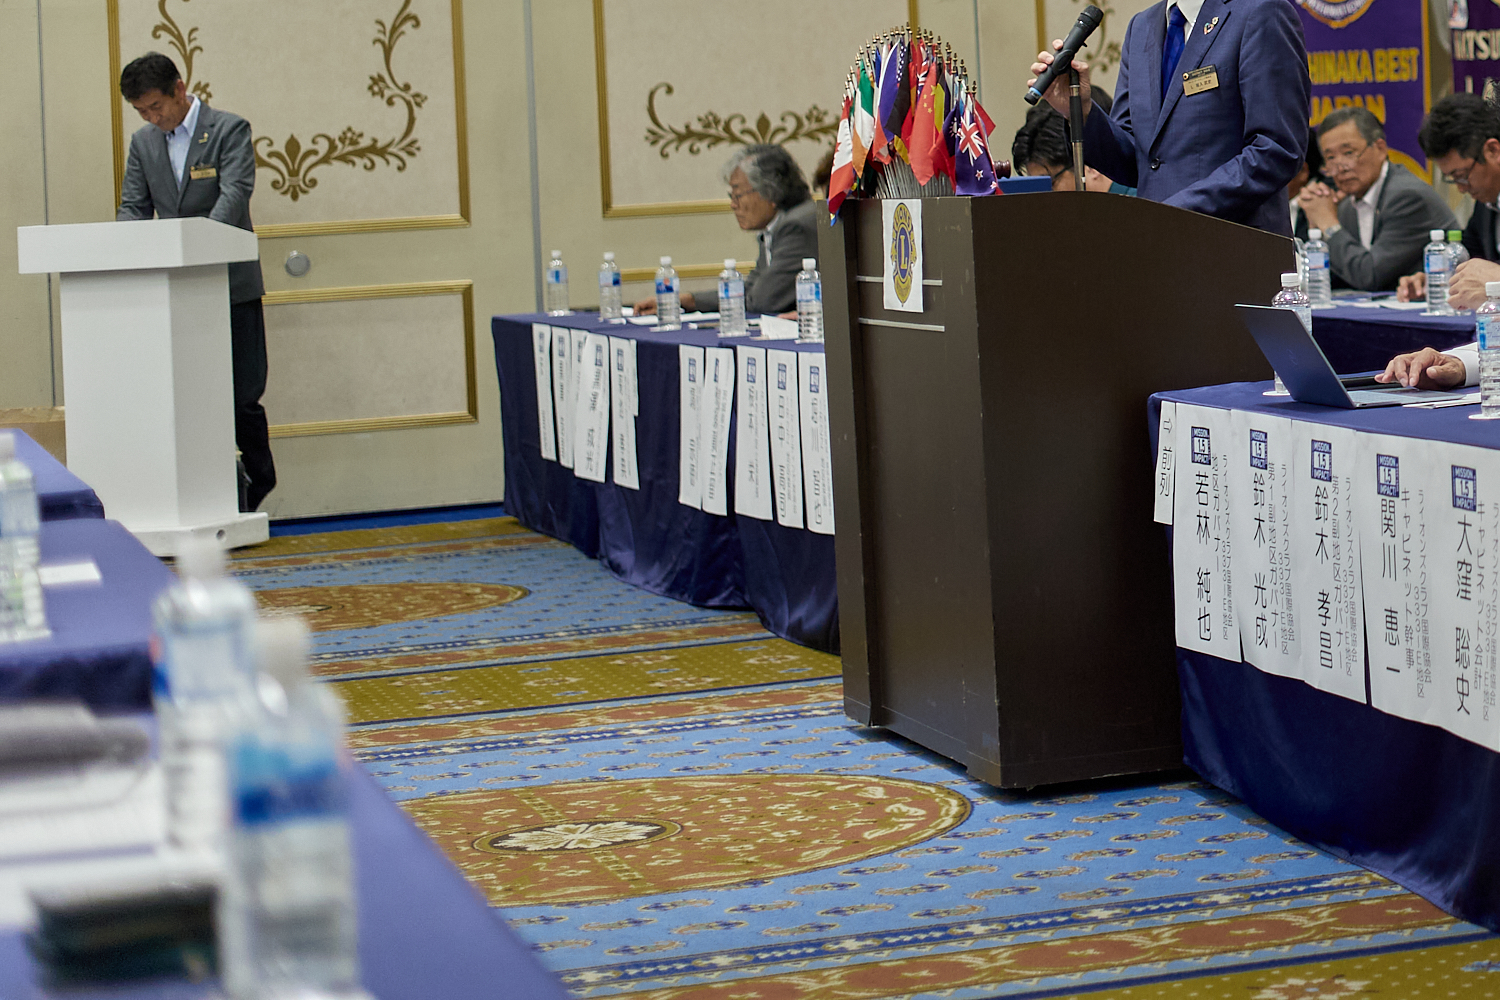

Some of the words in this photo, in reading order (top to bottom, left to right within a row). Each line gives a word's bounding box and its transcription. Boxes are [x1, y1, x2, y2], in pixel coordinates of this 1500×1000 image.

[1307, 51, 1373, 85] HINAKA
[1373, 47, 1419, 83] BEST
[900, 235, 909, 269] L
[1160, 446, 1173, 496] 前列
[1198, 439, 1206, 453] 1.5
[1317, 453, 1327, 469] 1.5
[1383, 468, 1391, 484] 1.5
[1195, 471, 1211, 545] 若林
[1253, 472, 1265, 548] 鈴木
[1315, 485, 1328, 564] 鈴木
[1460, 480, 1469, 496] 1.5
[1381, 499, 1397, 581] 関川
[1457, 514, 1472, 601] 大窪
[1197, 567, 1211, 641] 純也
[1254, 572, 1268, 649] 光成
[1318, 589, 1333, 669] 孝昌
[1384, 607, 1400, 673] 恵一
[1455, 627, 1471, 715] 聡史
